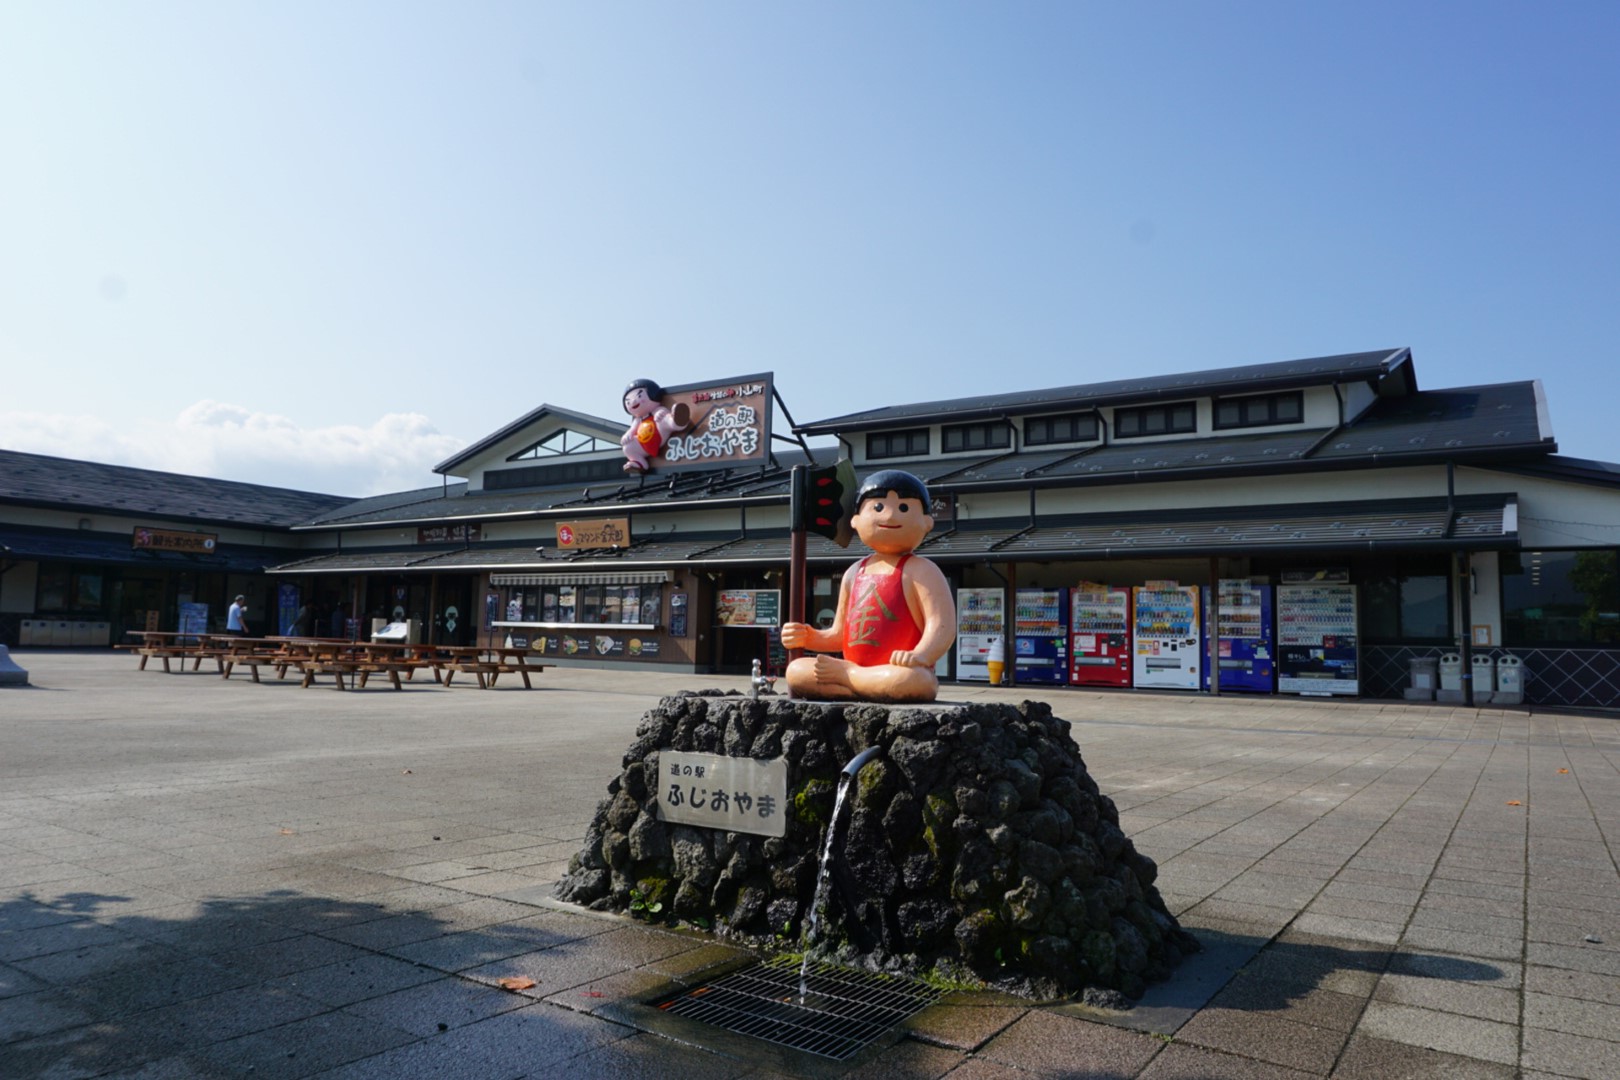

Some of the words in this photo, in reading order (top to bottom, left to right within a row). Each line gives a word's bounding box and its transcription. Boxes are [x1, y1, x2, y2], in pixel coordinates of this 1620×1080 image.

[709, 405, 755, 430] 道の駅
[666, 428, 758, 461] ふじおやま
[848, 582, 899, 647] 金
[671, 763, 705, 778] 道の駅
[667, 784, 776, 818] ふじおやま
